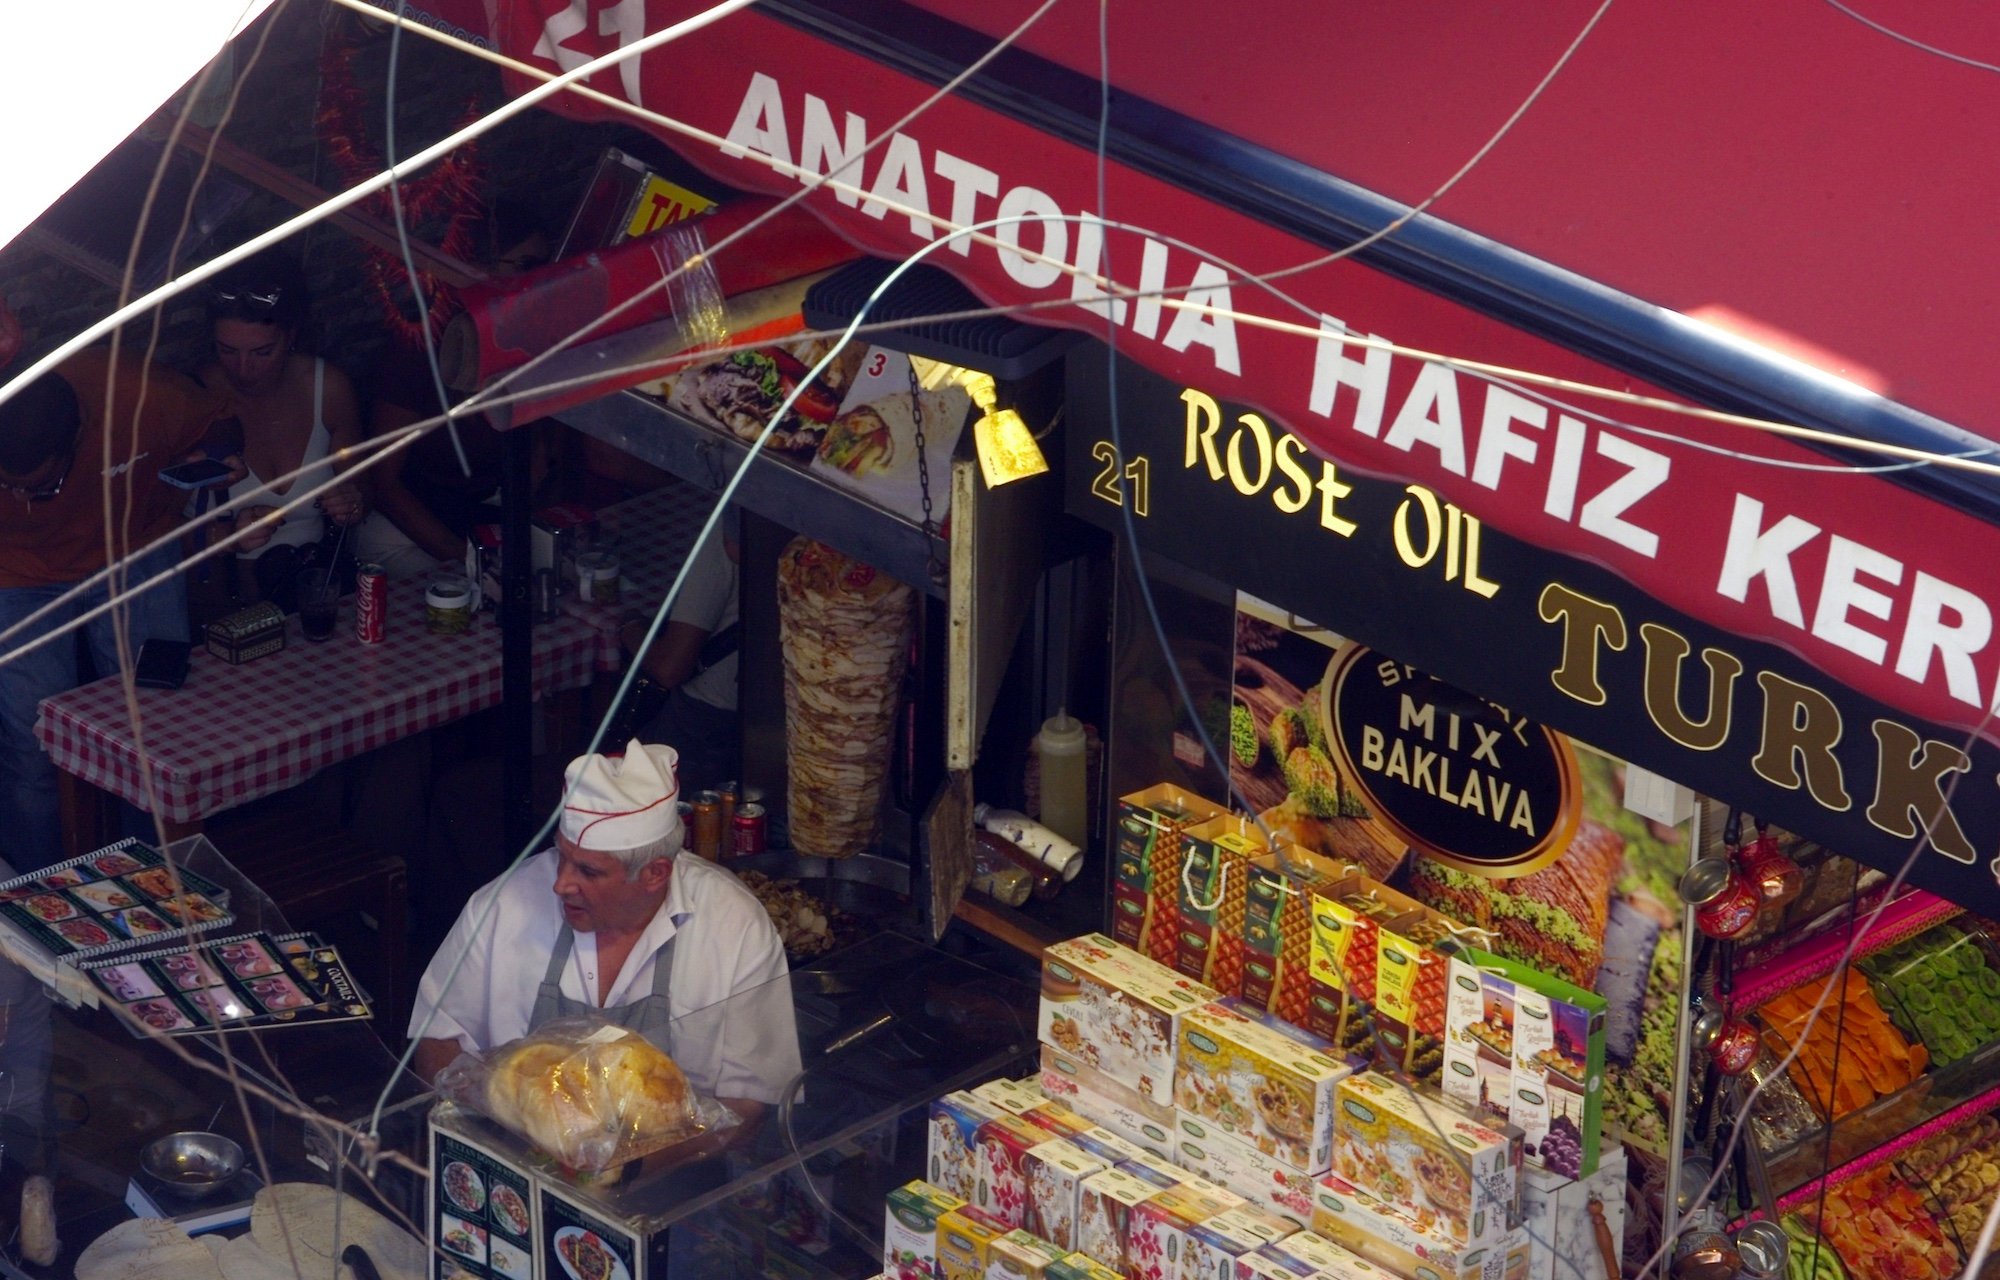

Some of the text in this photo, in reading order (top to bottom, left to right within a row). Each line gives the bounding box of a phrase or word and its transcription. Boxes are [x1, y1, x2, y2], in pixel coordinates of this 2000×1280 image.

[720, 71, 2000, 720] ANATOLIA HAFIZ KER
[867, 353, 887, 378] 3
[1091, 440, 1149, 517] 21
[1393, 484, 1500, 599] OIL
[1399, 692, 1502, 769] MIX
[1538, 582, 2000, 877] TURK
[1361, 723, 1536, 838] BAKLAVA
[327, 967, 356, 1001] COCKTAILS
